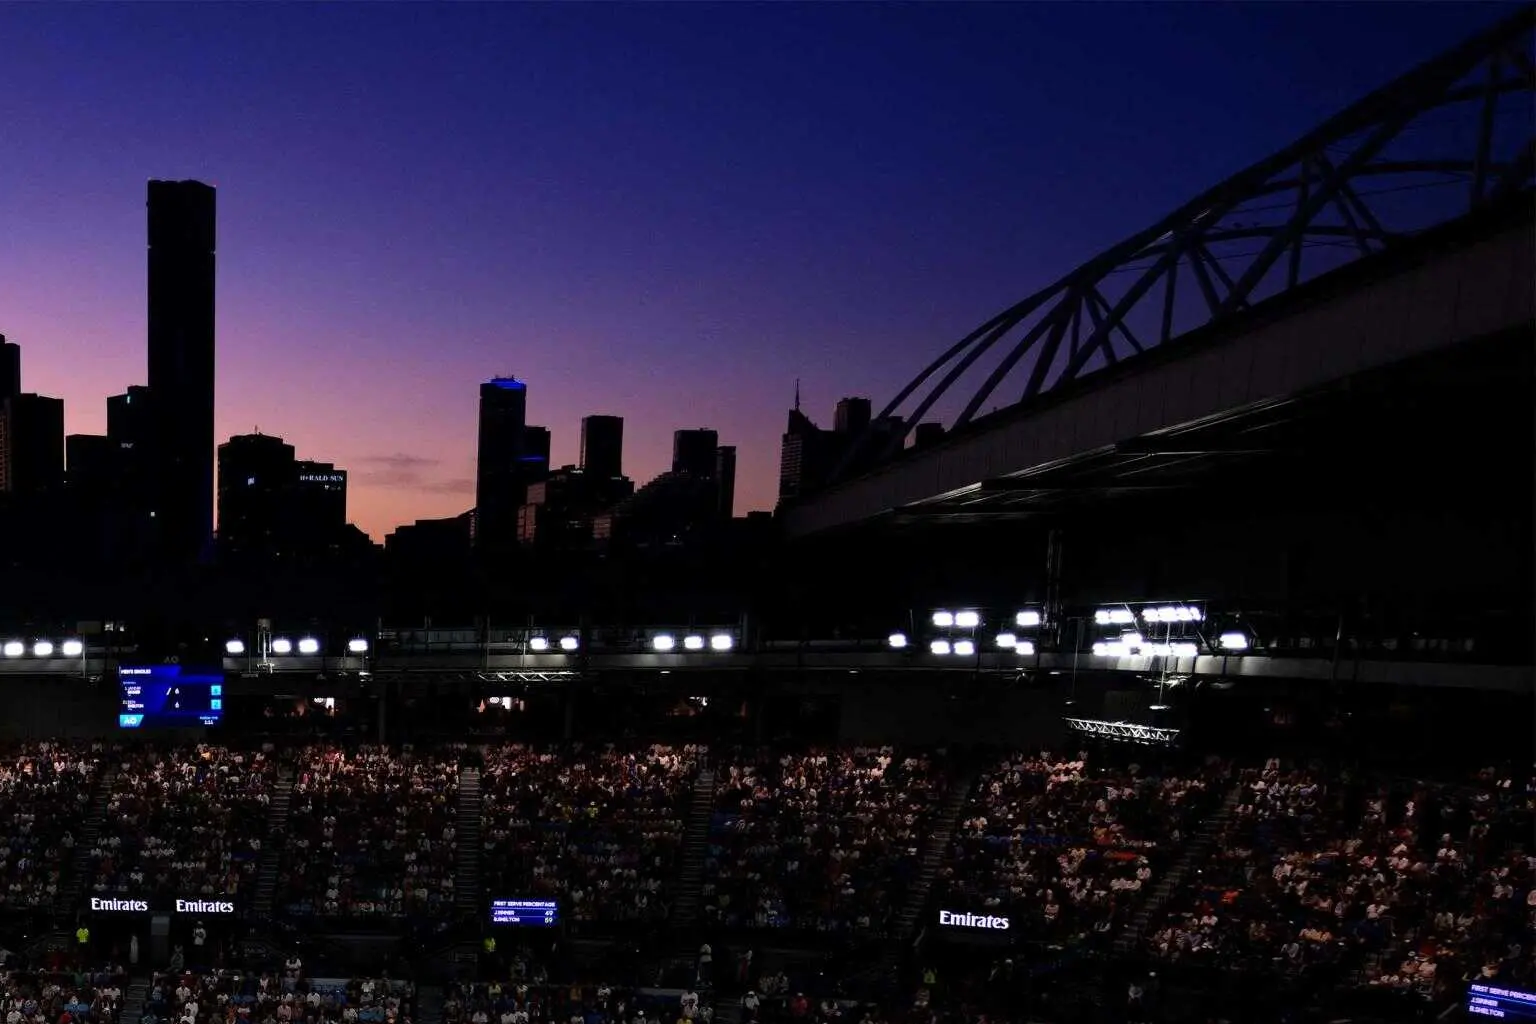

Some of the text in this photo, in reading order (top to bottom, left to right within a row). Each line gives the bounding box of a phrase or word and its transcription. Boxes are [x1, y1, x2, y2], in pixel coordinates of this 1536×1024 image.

[90, 898, 148, 912] Emirates
[176, 899, 234, 913] Emirates
[940, 910, 1010, 930] Emirates
